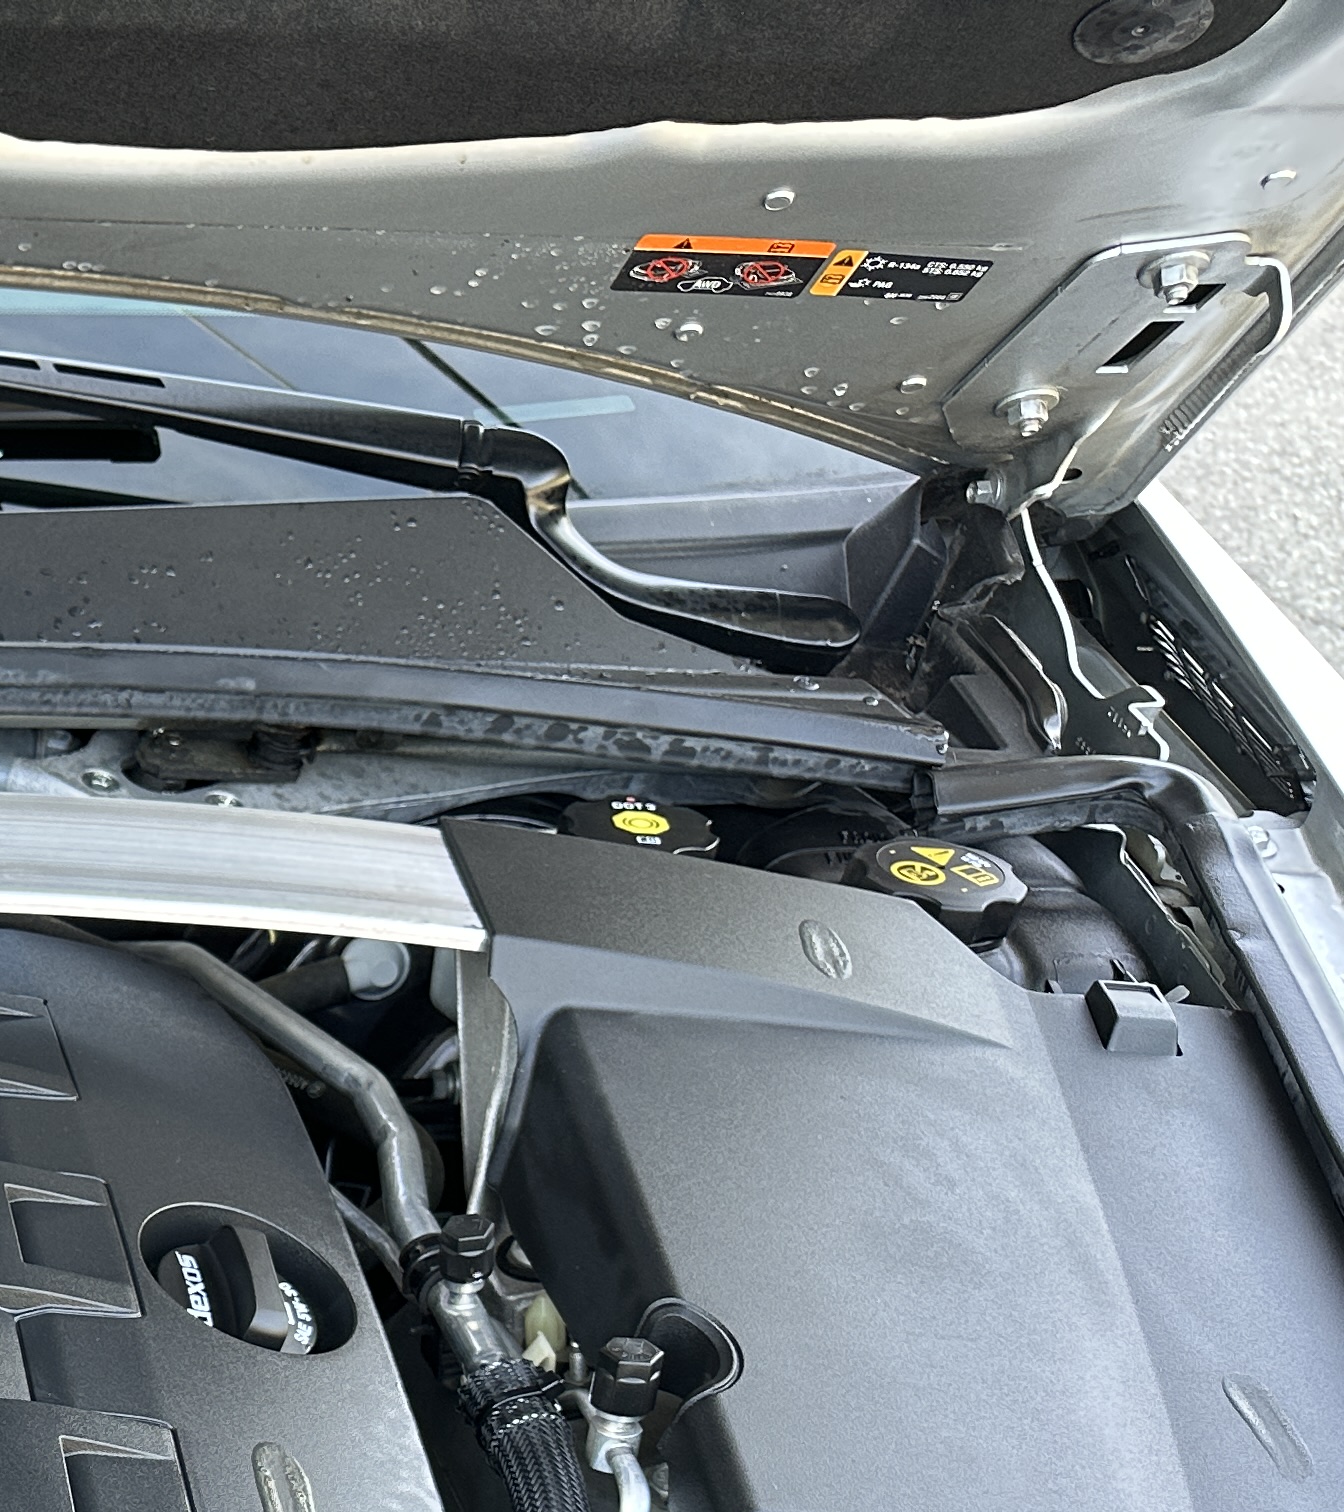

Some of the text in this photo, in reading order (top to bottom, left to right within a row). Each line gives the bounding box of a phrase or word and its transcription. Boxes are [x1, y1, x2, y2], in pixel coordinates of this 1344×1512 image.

[693, 280, 722, 290] AWD
[174, 1250, 214, 1327] dexos
[293, 1321, 314, 1345] SAE
